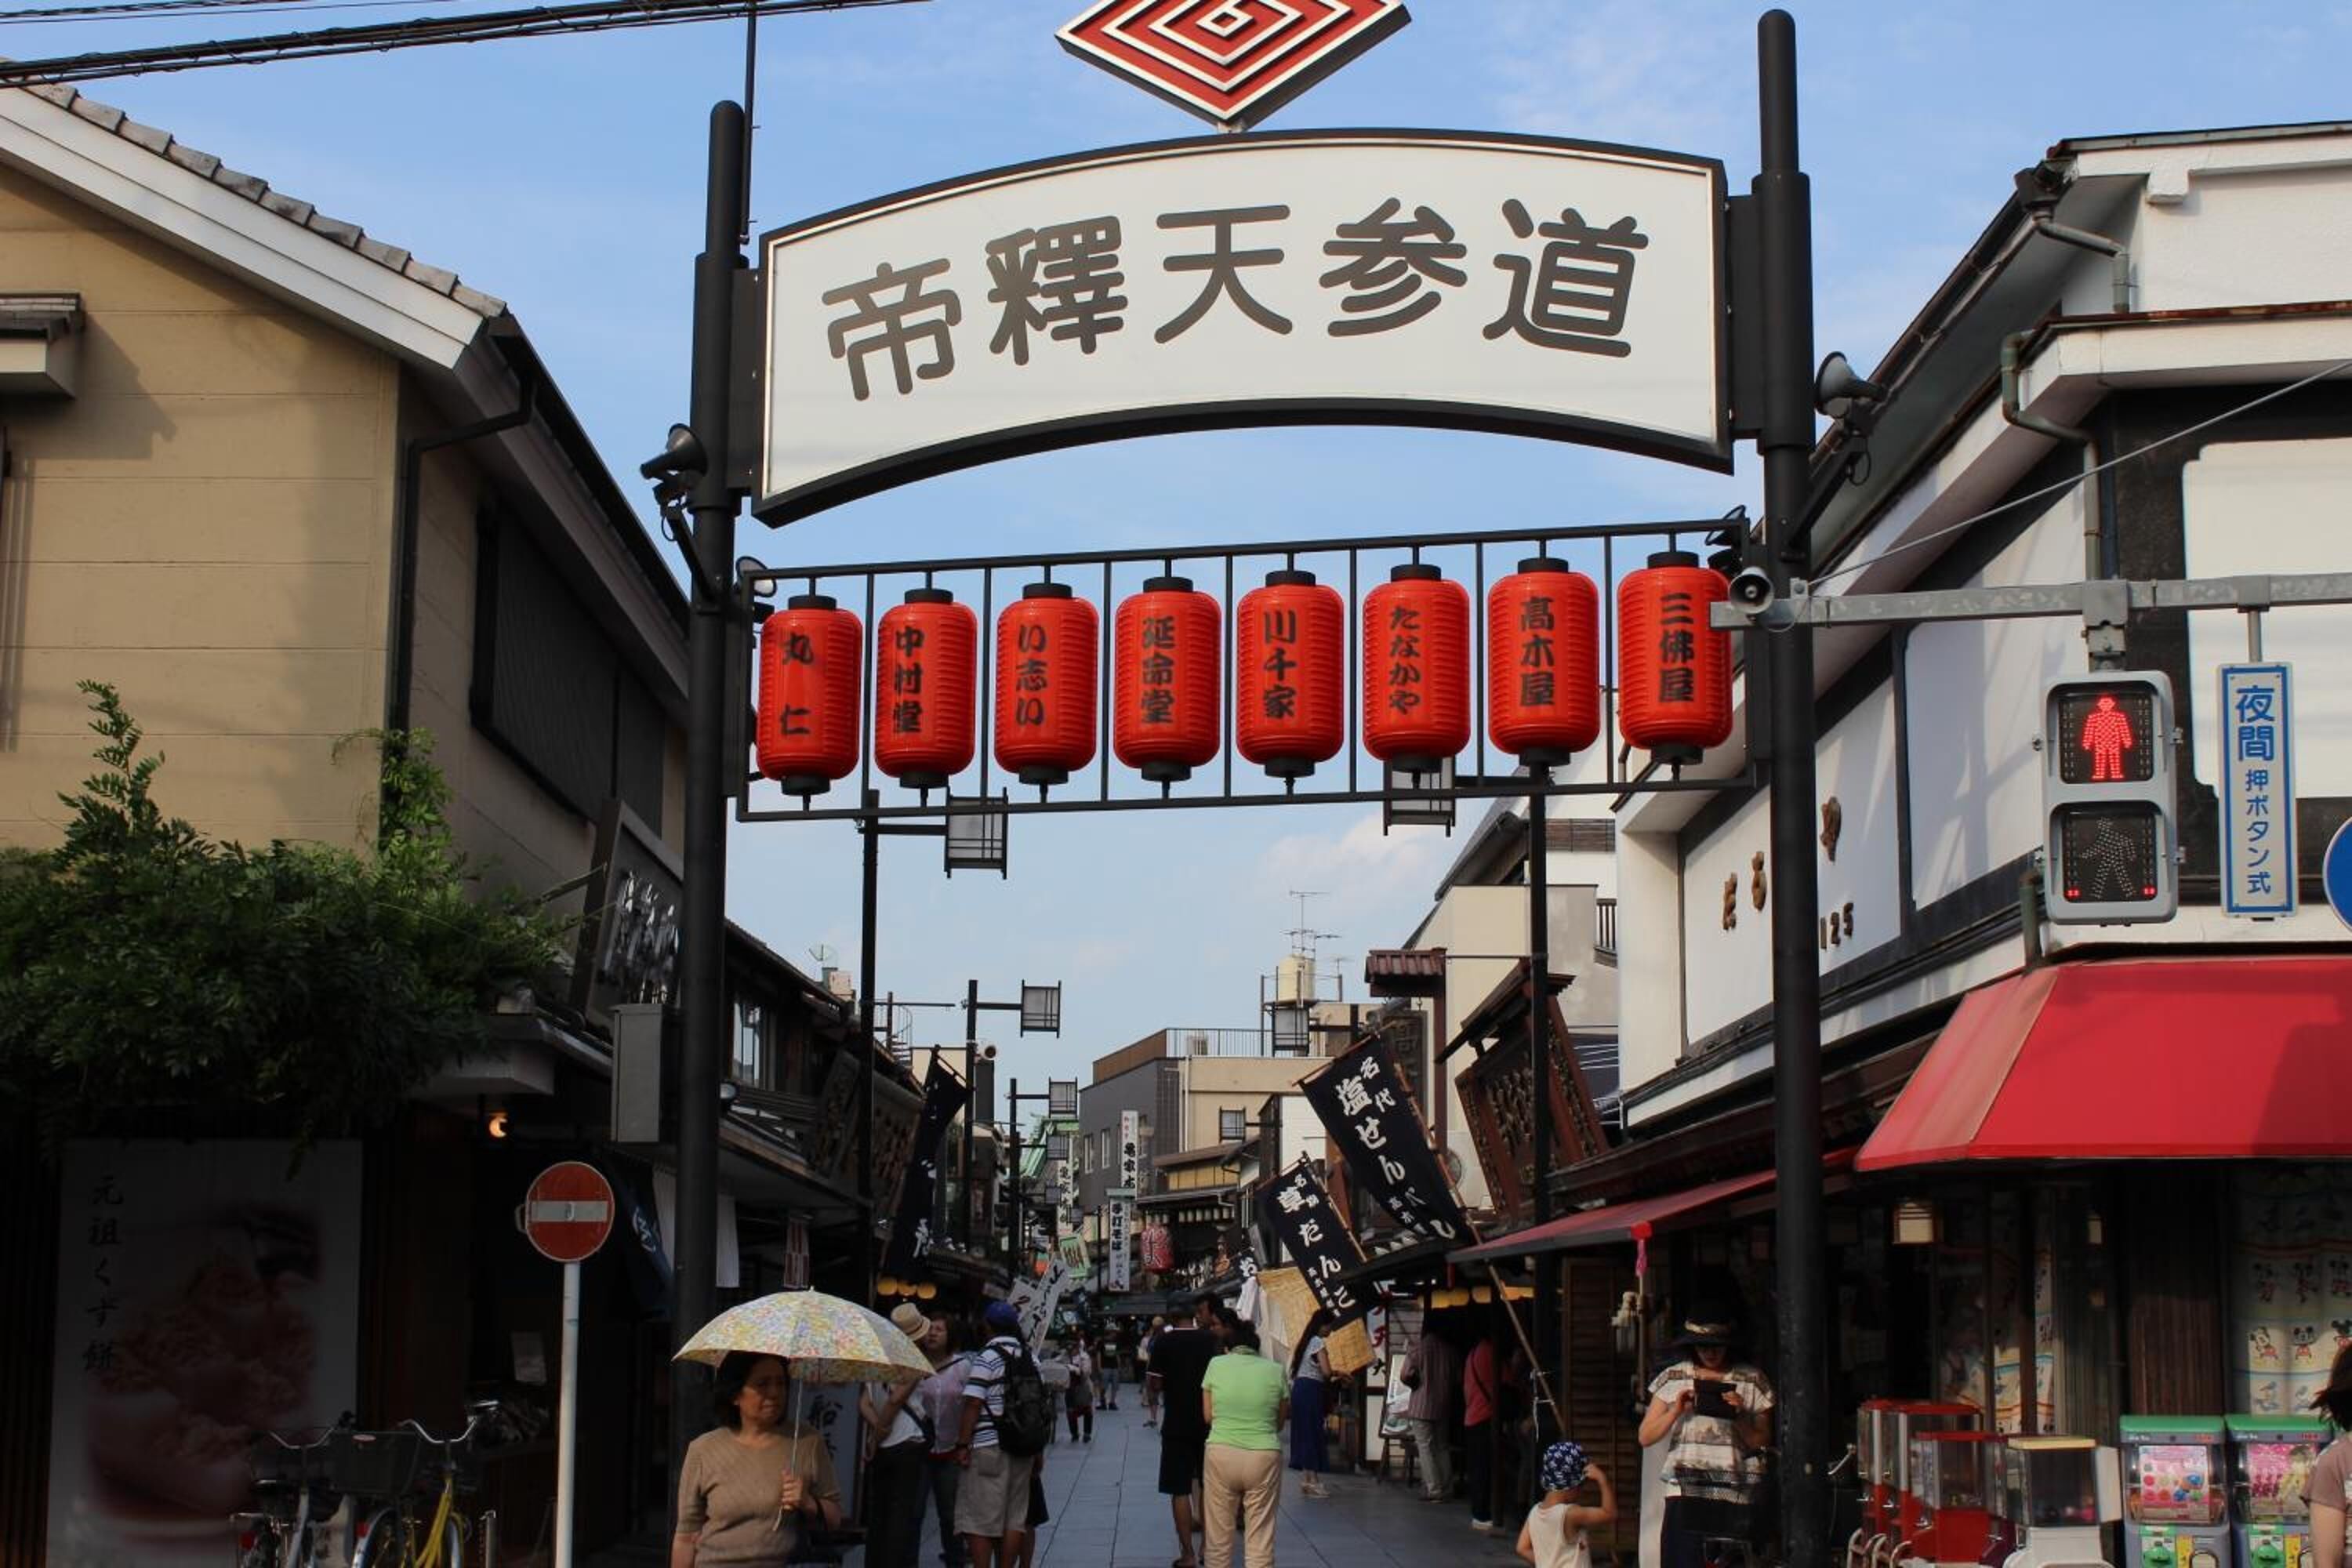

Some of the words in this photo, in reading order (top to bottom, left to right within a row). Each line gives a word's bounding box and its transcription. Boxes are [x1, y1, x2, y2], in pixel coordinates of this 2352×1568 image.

[821, 196, 1650, 402] 帝釋天参道
[1142, 615, 1175, 724] 延命堂
[1262, 609, 1298, 720] 川千家
[1388, 605, 1421, 715] たなかや
